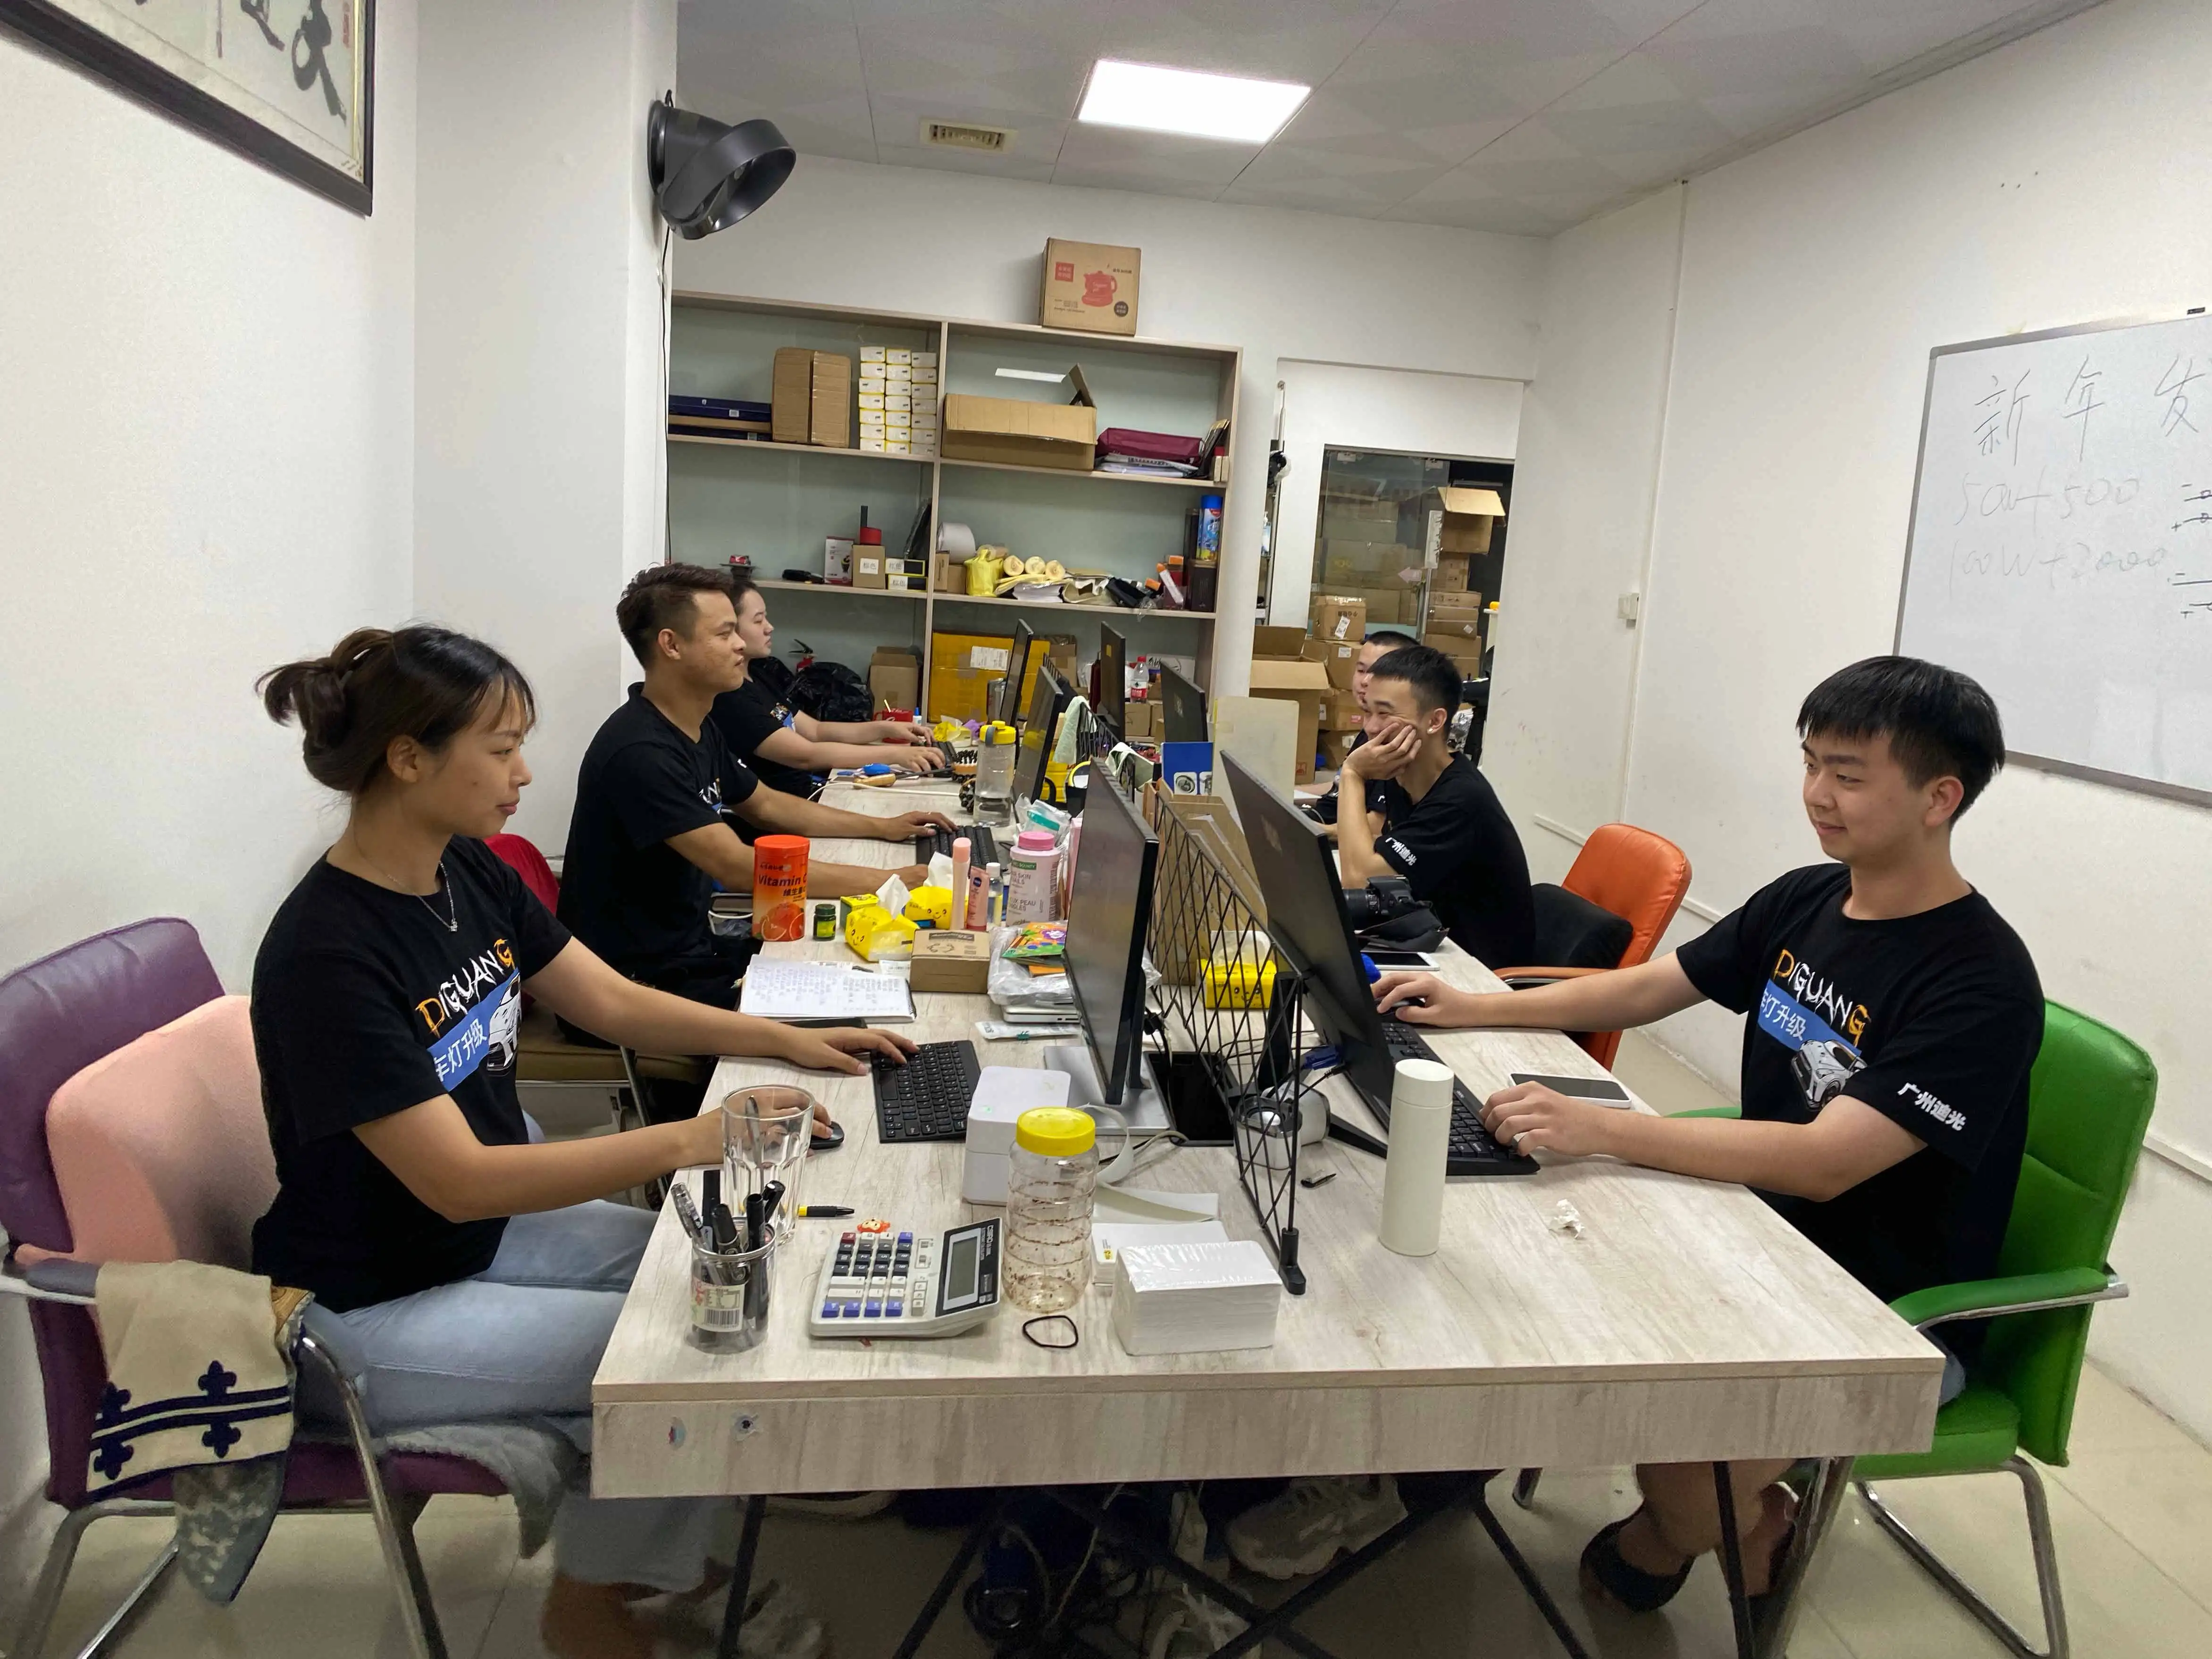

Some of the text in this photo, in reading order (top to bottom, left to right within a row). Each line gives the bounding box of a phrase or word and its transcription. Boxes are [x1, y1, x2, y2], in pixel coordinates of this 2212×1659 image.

[759, 873, 801, 887] Vitamin
[415, 938, 515, 1038] DIGUANG
[1772, 948, 1872, 1047] DIGUANG
[1897, 1082, 1967, 1131] 广州迪光
